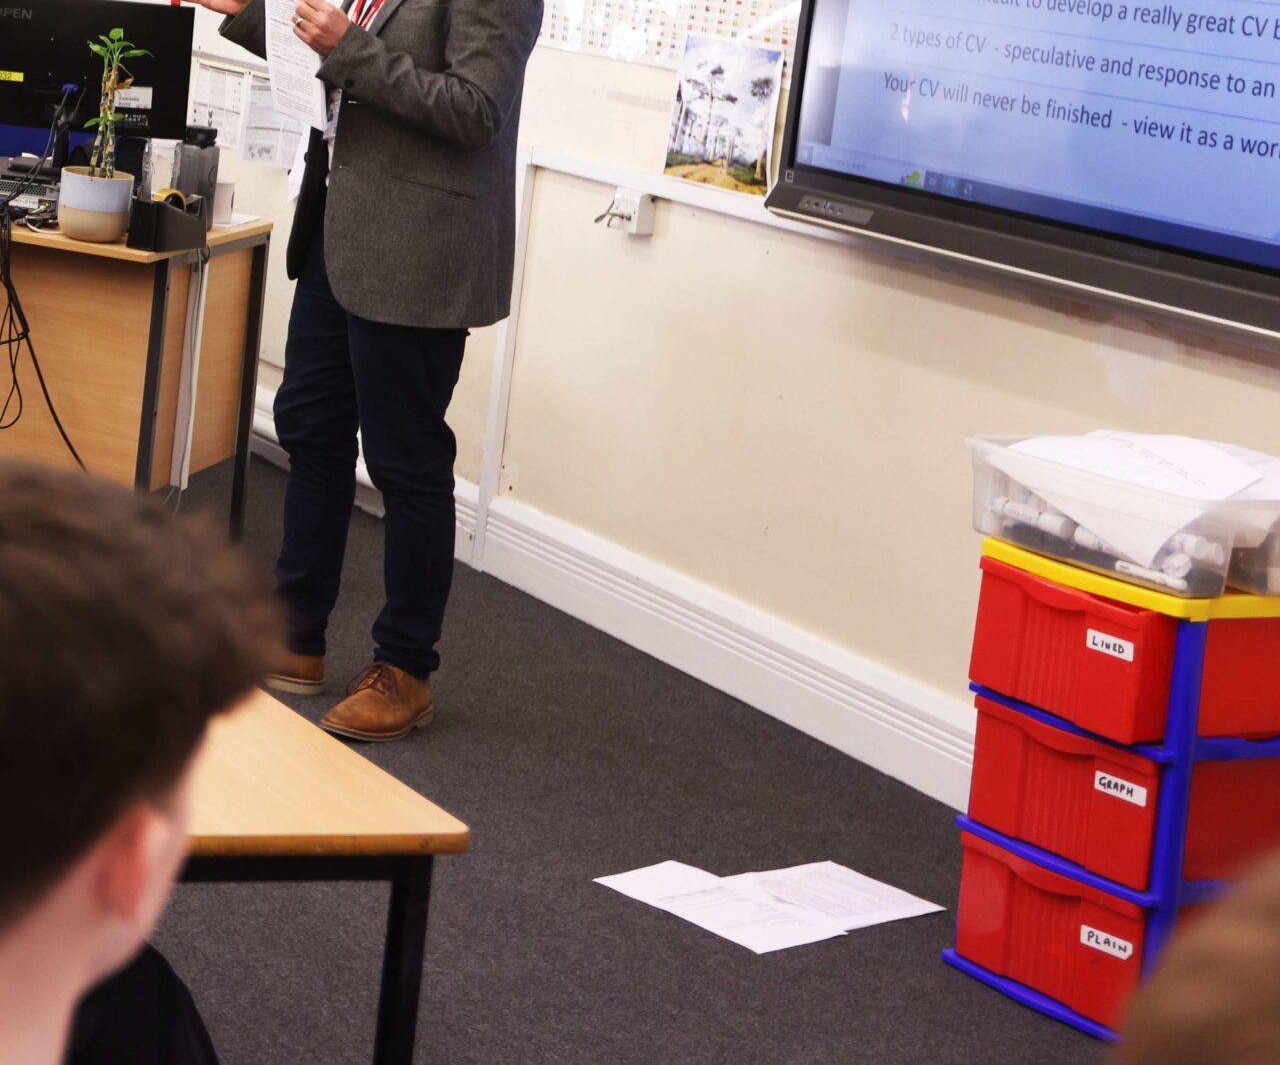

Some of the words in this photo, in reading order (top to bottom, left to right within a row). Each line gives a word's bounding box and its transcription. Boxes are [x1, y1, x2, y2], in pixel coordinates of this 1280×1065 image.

[1118, 6, 1128, 21] a
[1133, 5, 1182, 31] really
[1186, 12, 1236, 35] great
[1241, 15, 1268, 38] CV
[890, 23, 899, 41] 2
[903, 27, 942, 48] types
[945, 31, 963, 51] of
[965, 33, 987, 54] CV
[1004, 41, 1096, 72] speculative
[1100, 56, 1133, 77] and
[1138, 62, 1221, 91] response
[1227, 73, 1246, 94] to
[1251, 80, 1276, 98] an
[884, 72, 914, 93] Your
[919, 78, 940, 98] CV
[943, 83, 969, 104] will
[973, 92, 1017, 113] never
[1021, 95, 1041, 117] be
[1046, 99, 1112, 130] finished
[1133, 115, 1175, 141] view
[1180, 122, 1193, 143] it
[1198, 130, 1218, 149] as
[1223, 134, 1234, 151] a
[1241, 137, 1280, 159] wor
[1092, 635, 1125, 654] LINED
[1098, 774, 1135, 799] GRAPH
[1087, 930, 1130, 955] PLAIN
